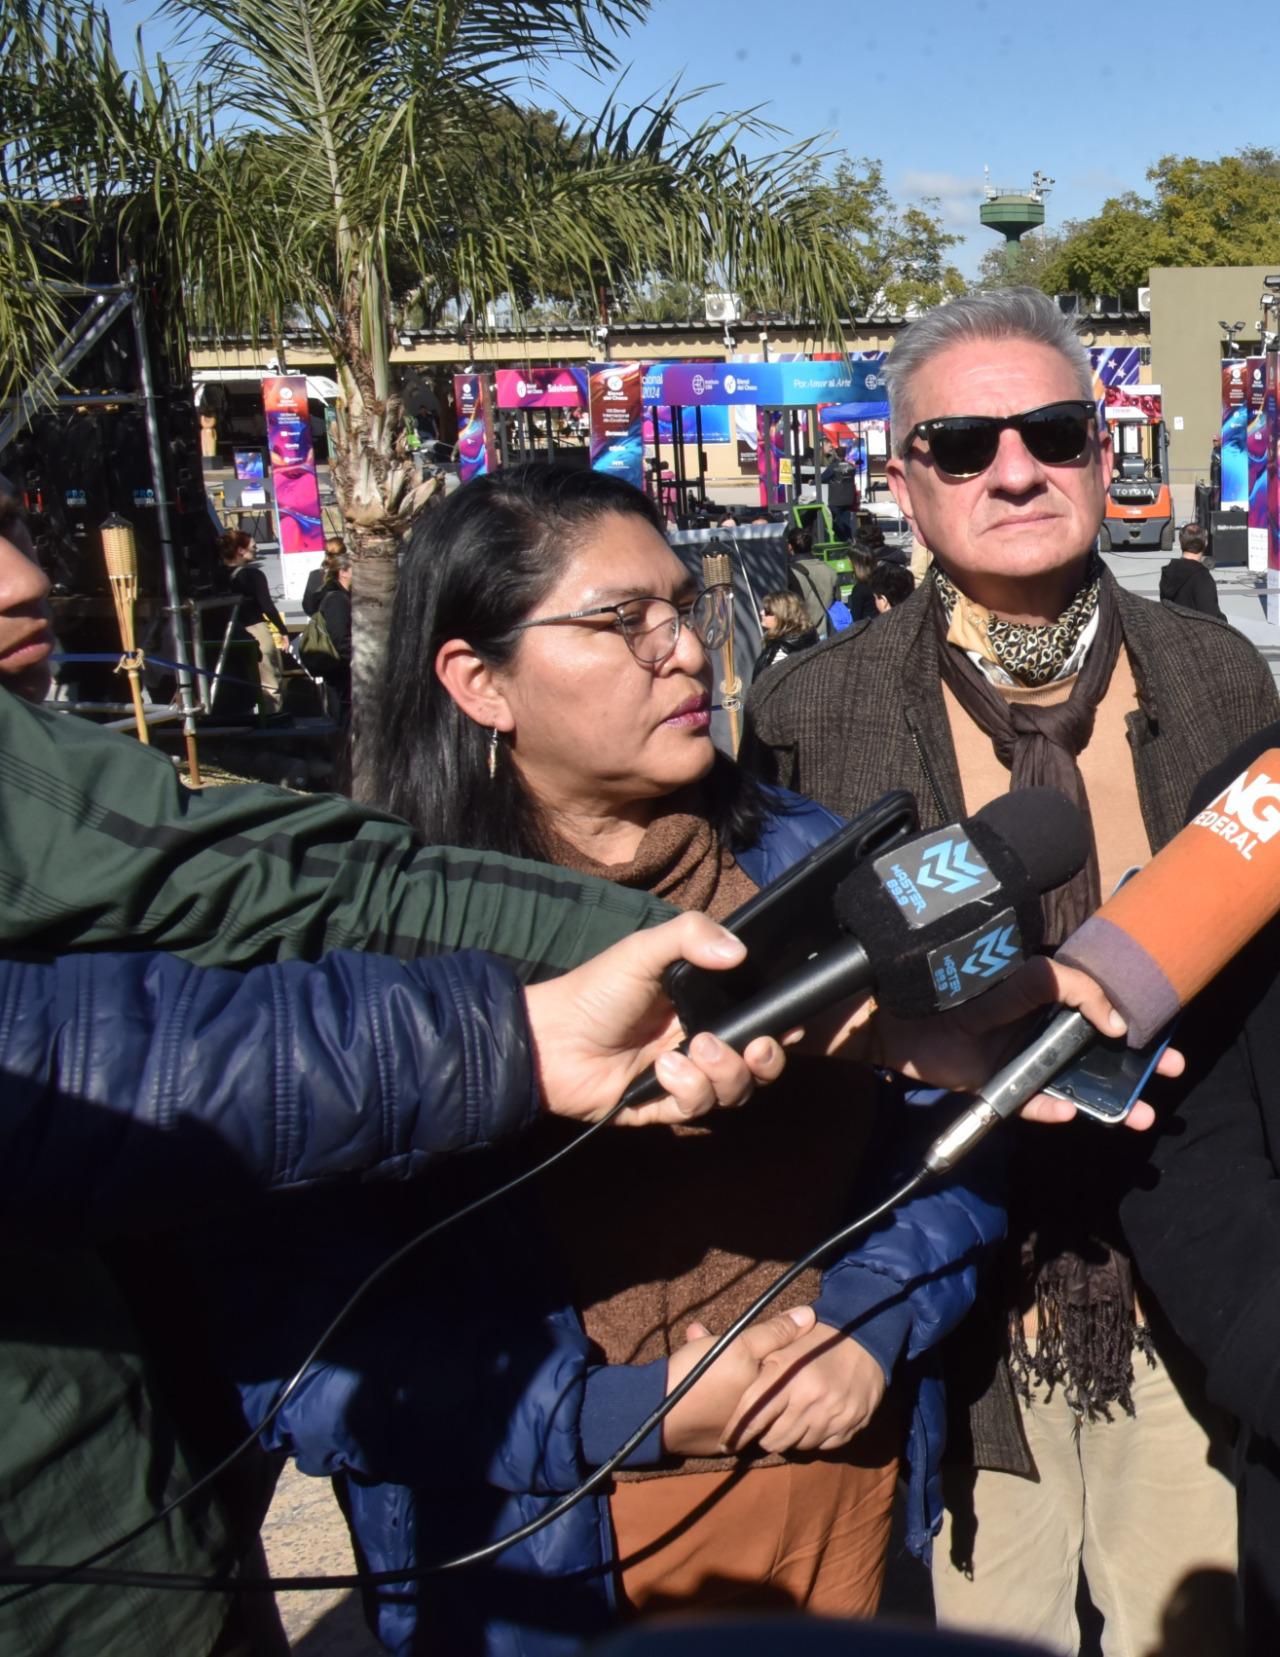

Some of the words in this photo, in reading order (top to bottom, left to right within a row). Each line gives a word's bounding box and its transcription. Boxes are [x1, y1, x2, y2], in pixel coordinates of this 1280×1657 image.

[793, 379, 807, 389] Por
[1115, 488, 1152, 496] TOYOTA
[1191, 810, 1258, 861] EDERAL
[890, 863, 928, 915] MASTER
[943, 955, 962, 997] MASTER
